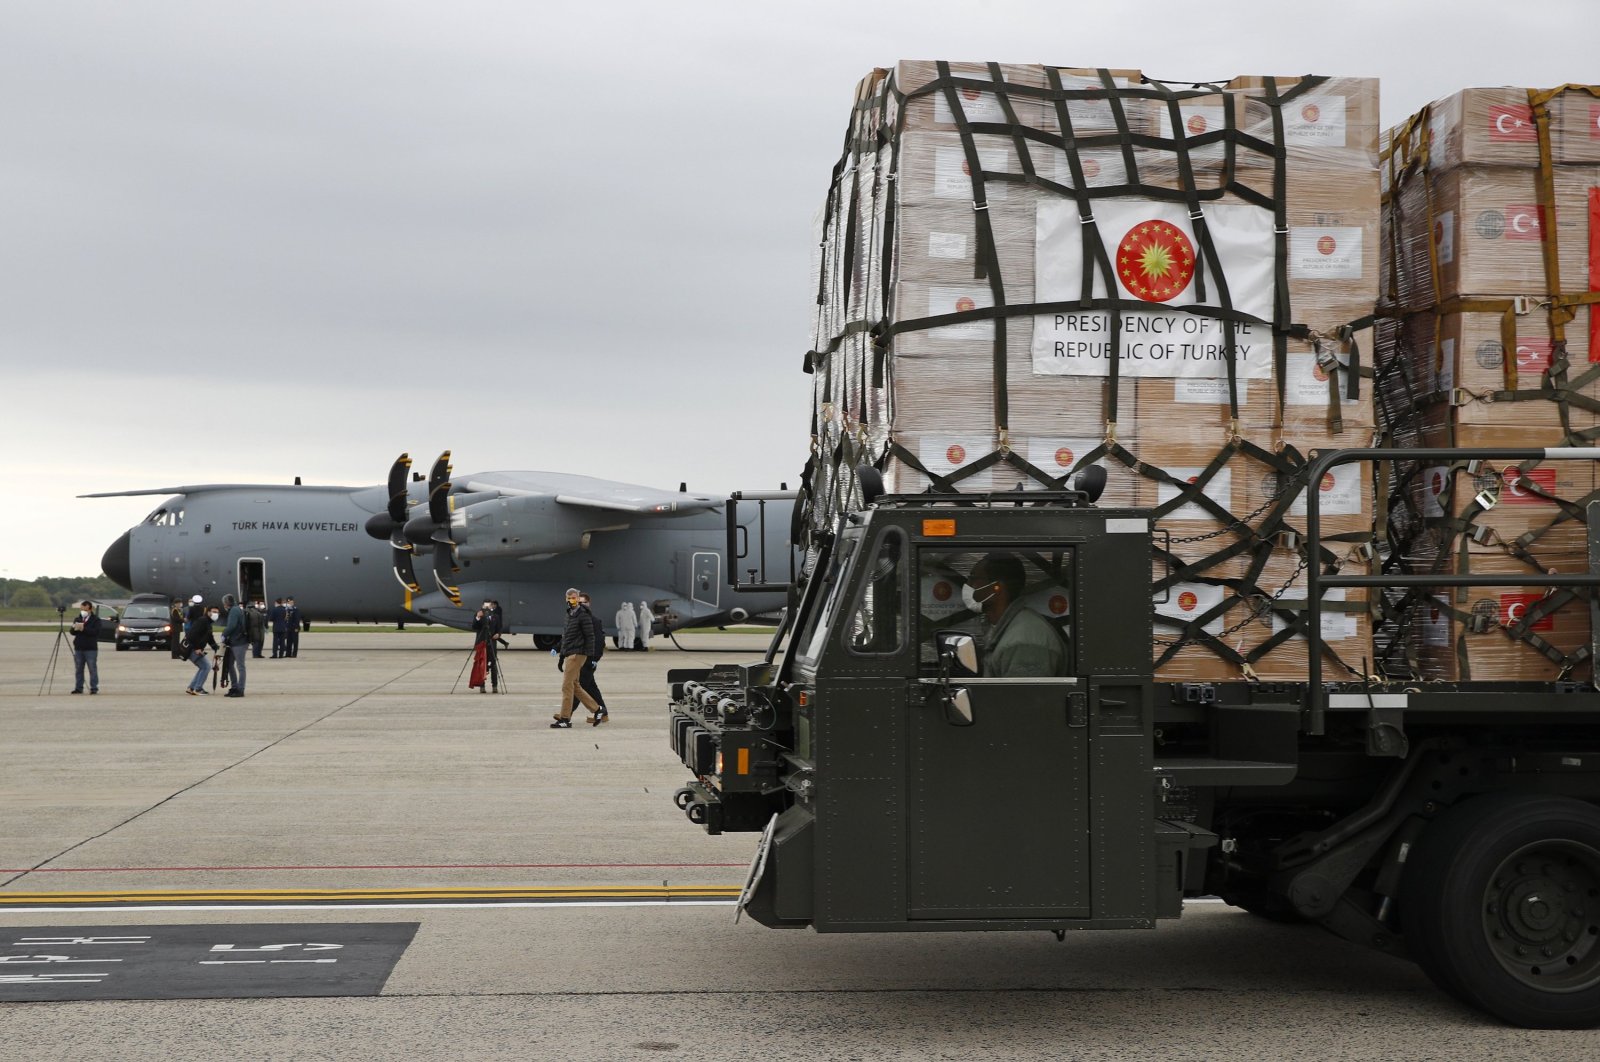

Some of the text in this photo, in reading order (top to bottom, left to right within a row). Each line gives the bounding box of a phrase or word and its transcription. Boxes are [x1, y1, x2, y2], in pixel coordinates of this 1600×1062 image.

[1055, 314, 1176, 334] PRESIENCY
[1183, 318, 1209, 334] OF
[1150, 343, 1175, 360] OF
[262, 521, 289, 531] HAVA
